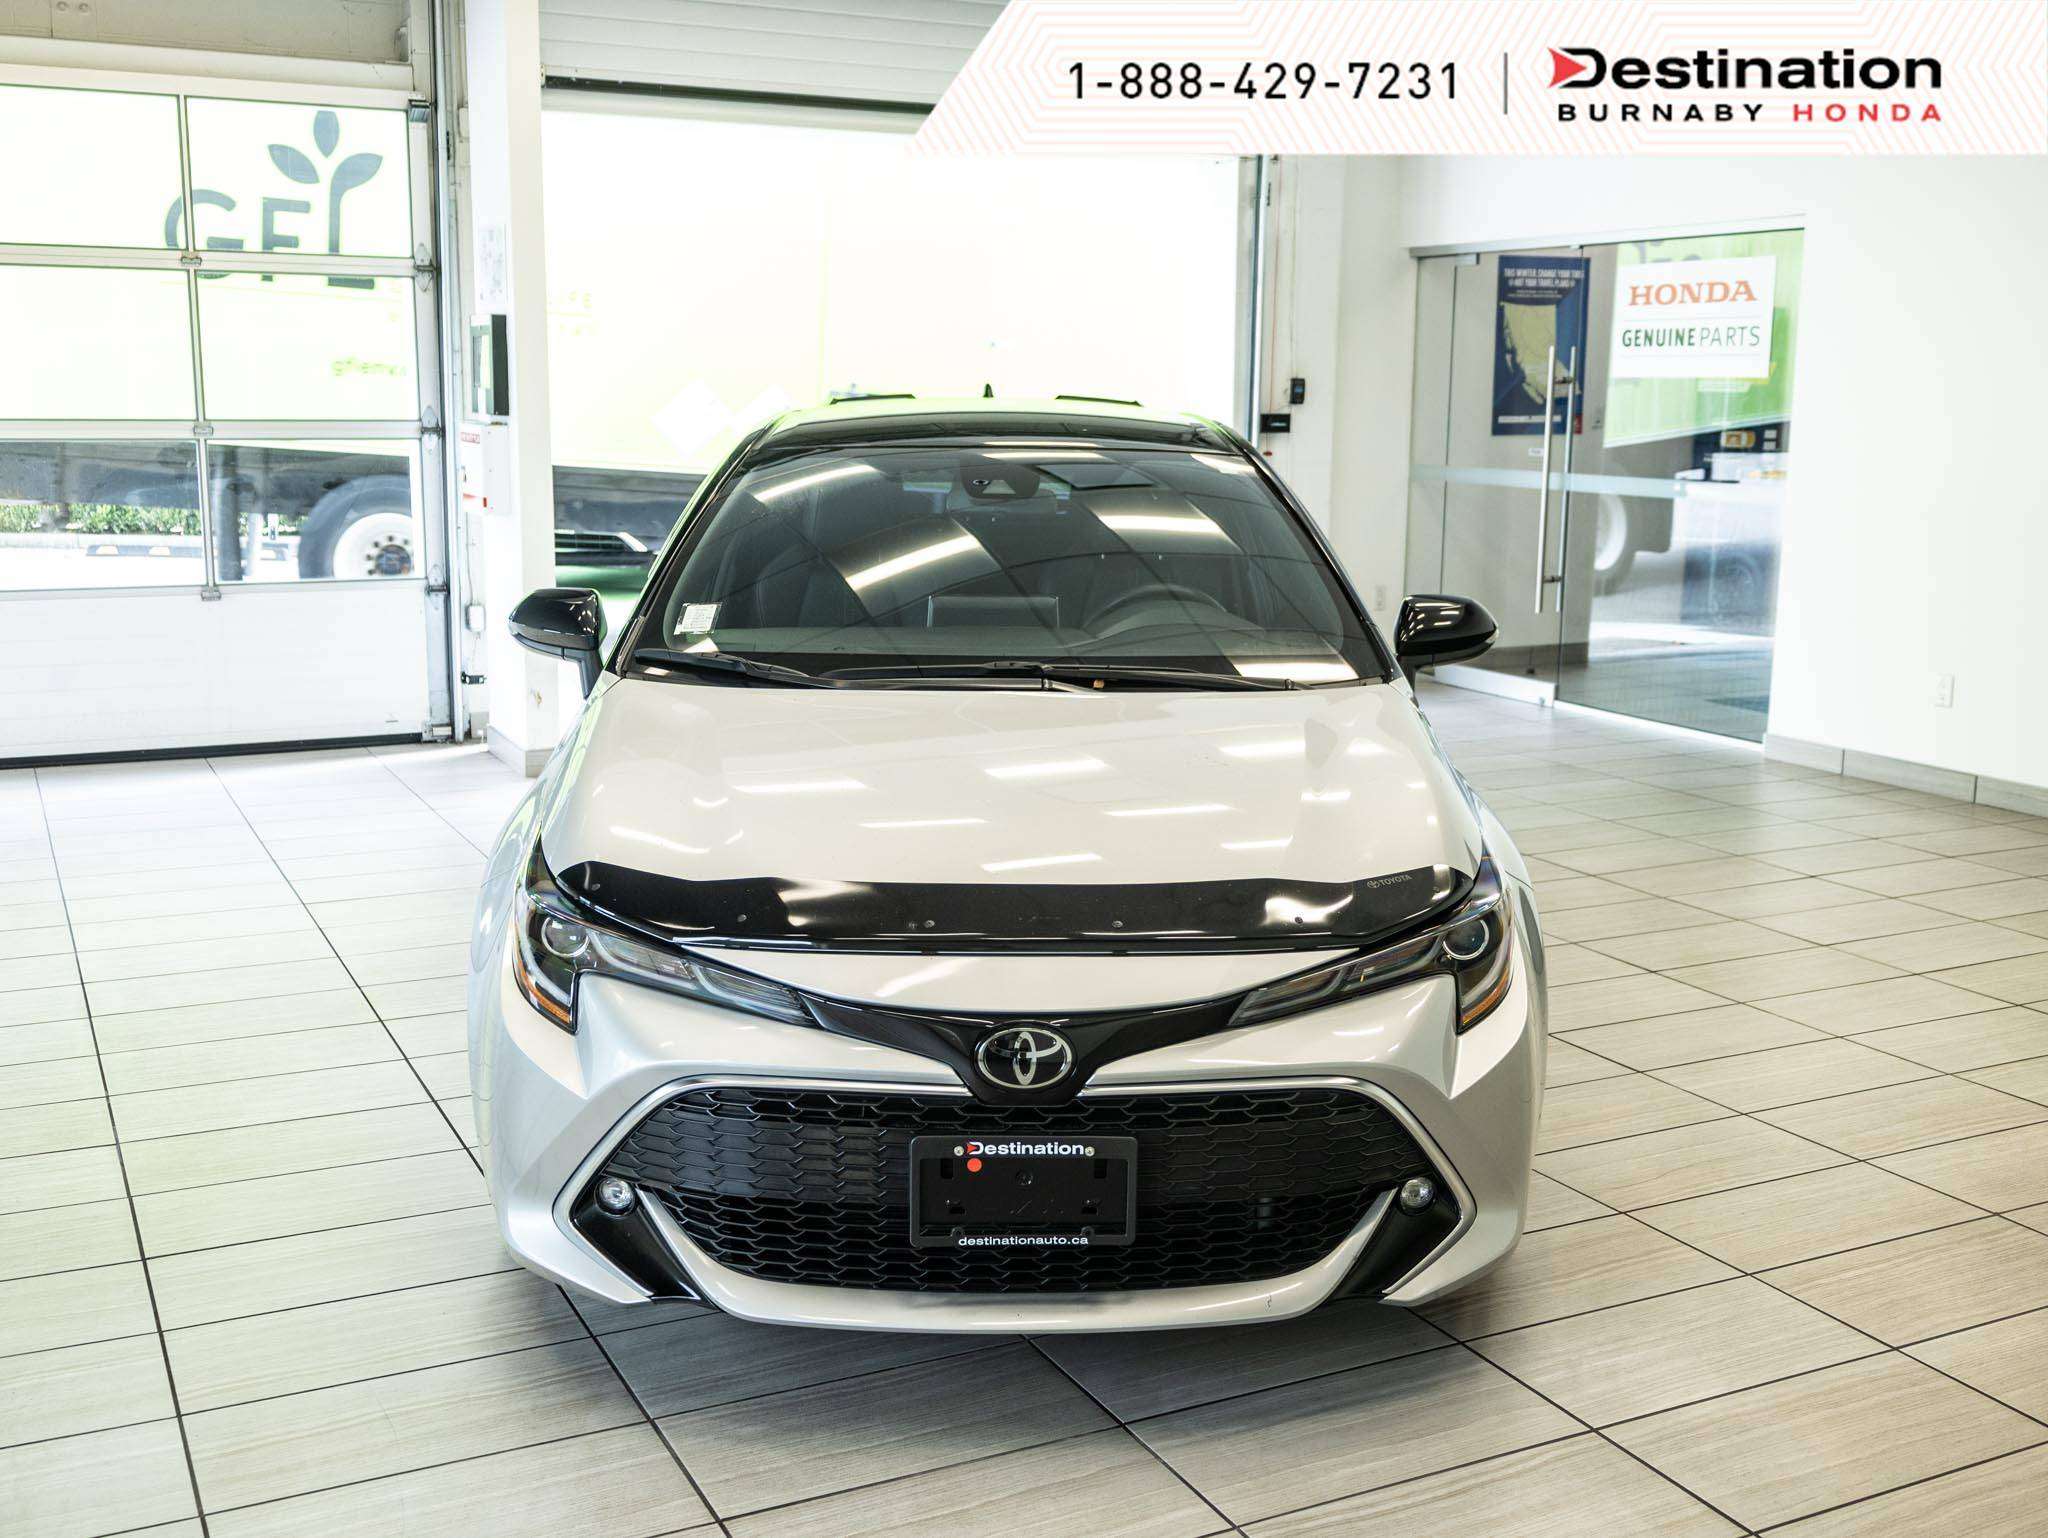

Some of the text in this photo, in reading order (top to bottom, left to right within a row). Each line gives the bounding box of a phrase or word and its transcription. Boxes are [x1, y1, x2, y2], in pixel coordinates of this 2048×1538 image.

[1628, 280, 1759, 306] HONDA
[1622, 325, 1761, 347] GENUINE PARTS
[1380, 874, 1412, 886] TOYOTA
[966, 1141, 1085, 1155] Destination
[958, 1236, 1089, 1246] destinationauto.ca
